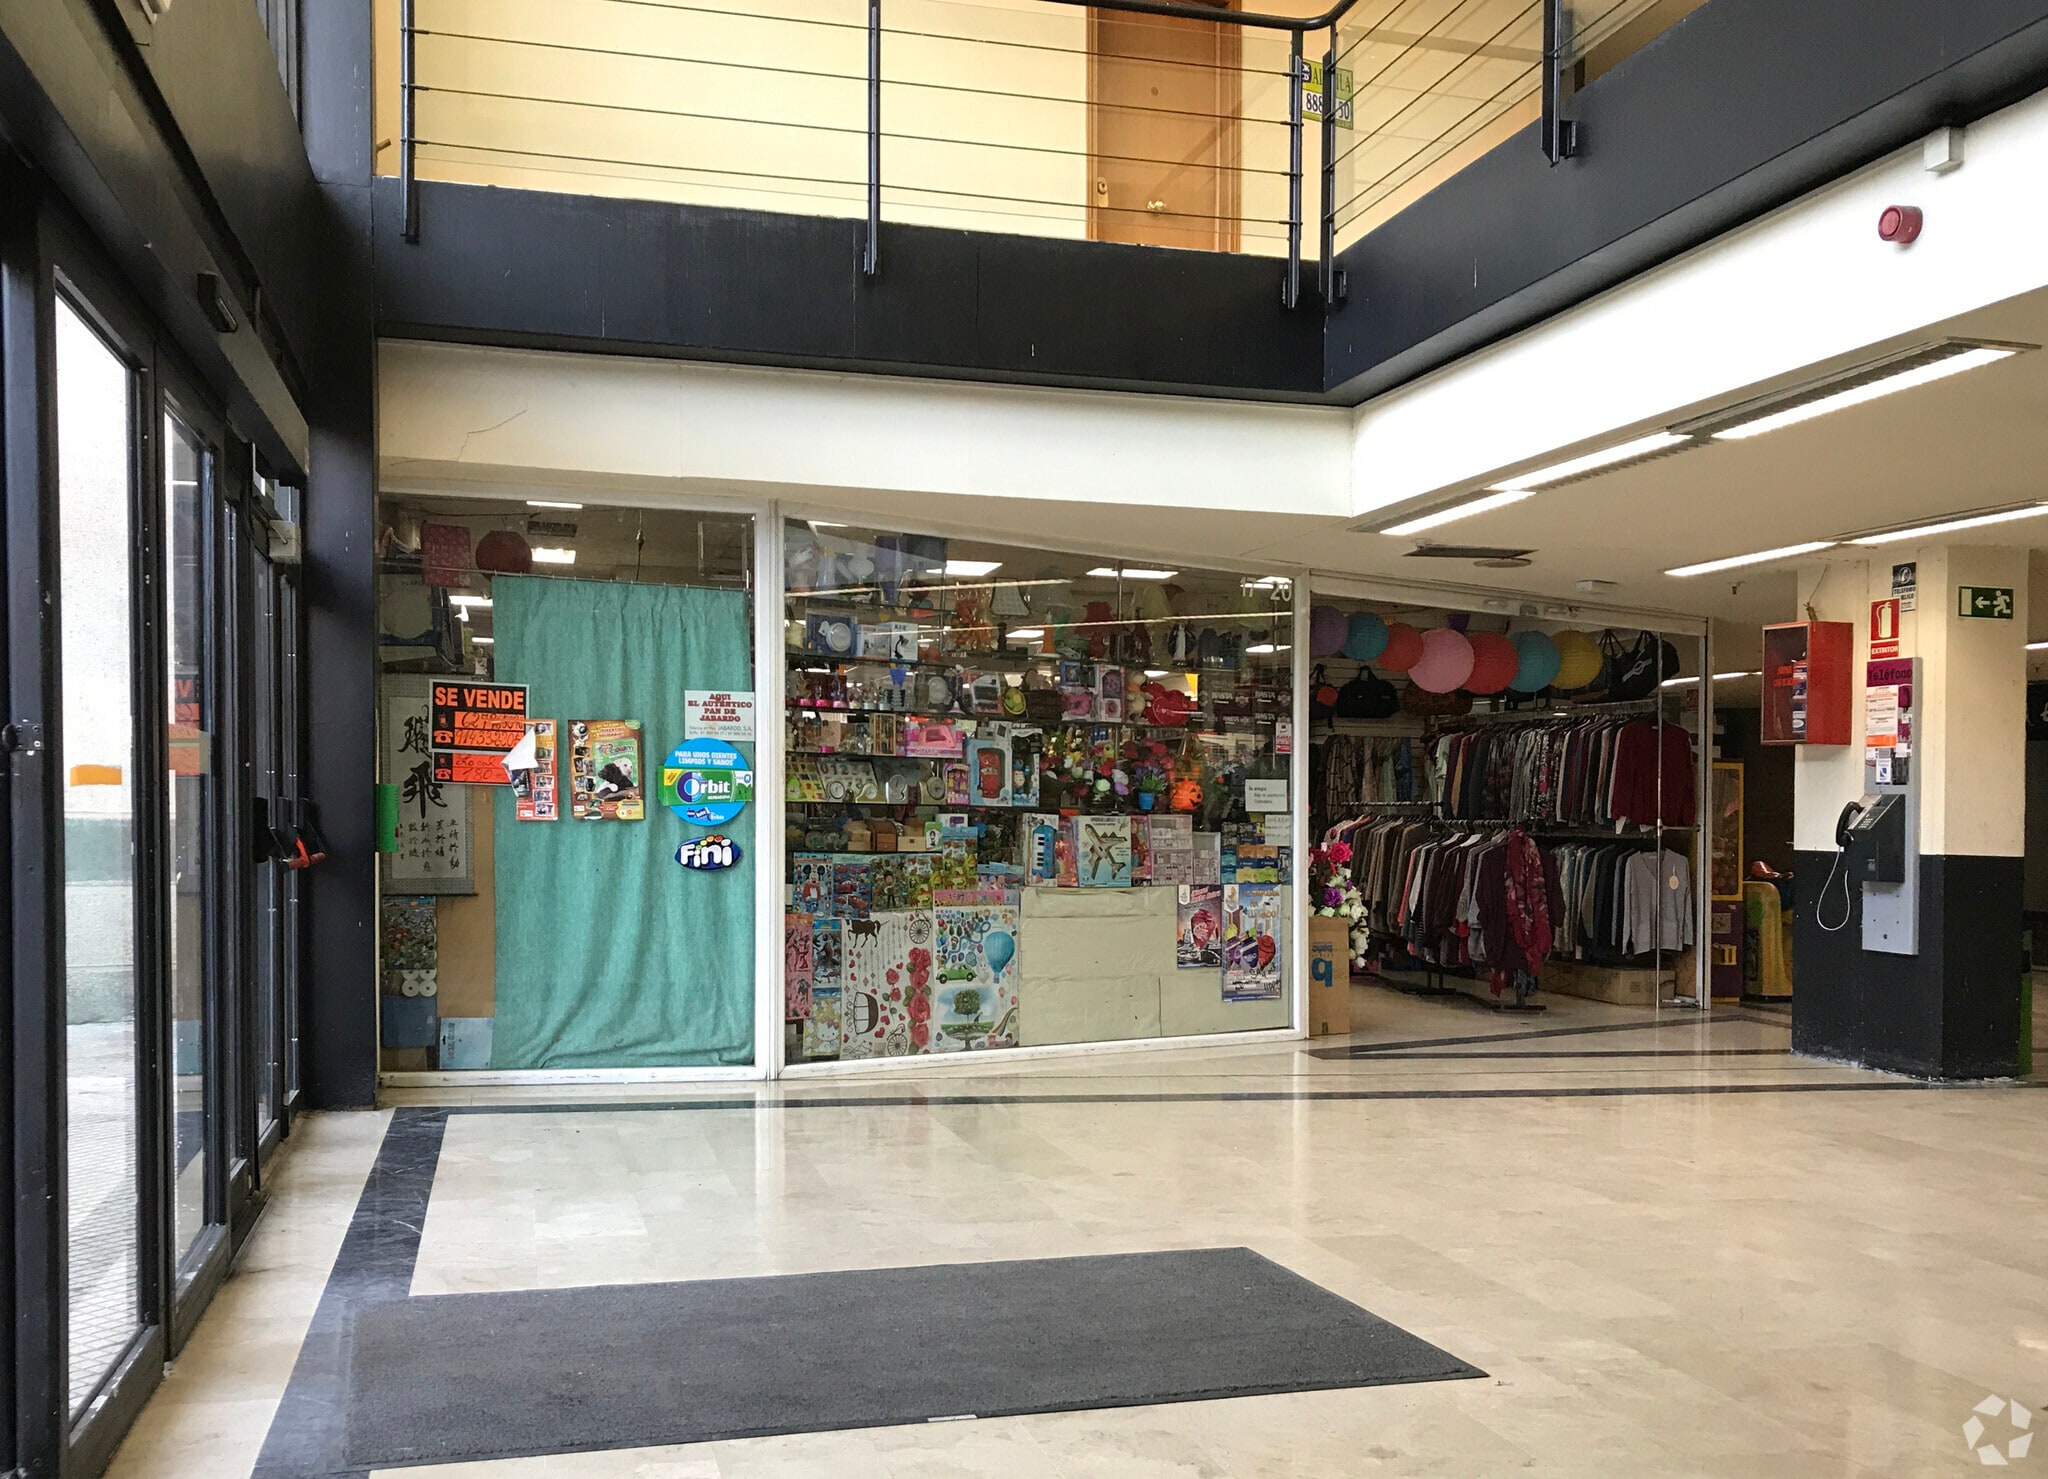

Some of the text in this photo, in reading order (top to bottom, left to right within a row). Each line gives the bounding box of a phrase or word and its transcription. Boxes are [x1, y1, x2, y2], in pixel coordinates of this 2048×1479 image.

[1240, 576, 1292, 601] 17 20
[1871, 645, 1898, 655] EXTINTOR
[435, 686, 525, 710] SE VENDE
[711, 752, 737, 760] DIENTES
[680, 839, 733, 868] Fini
